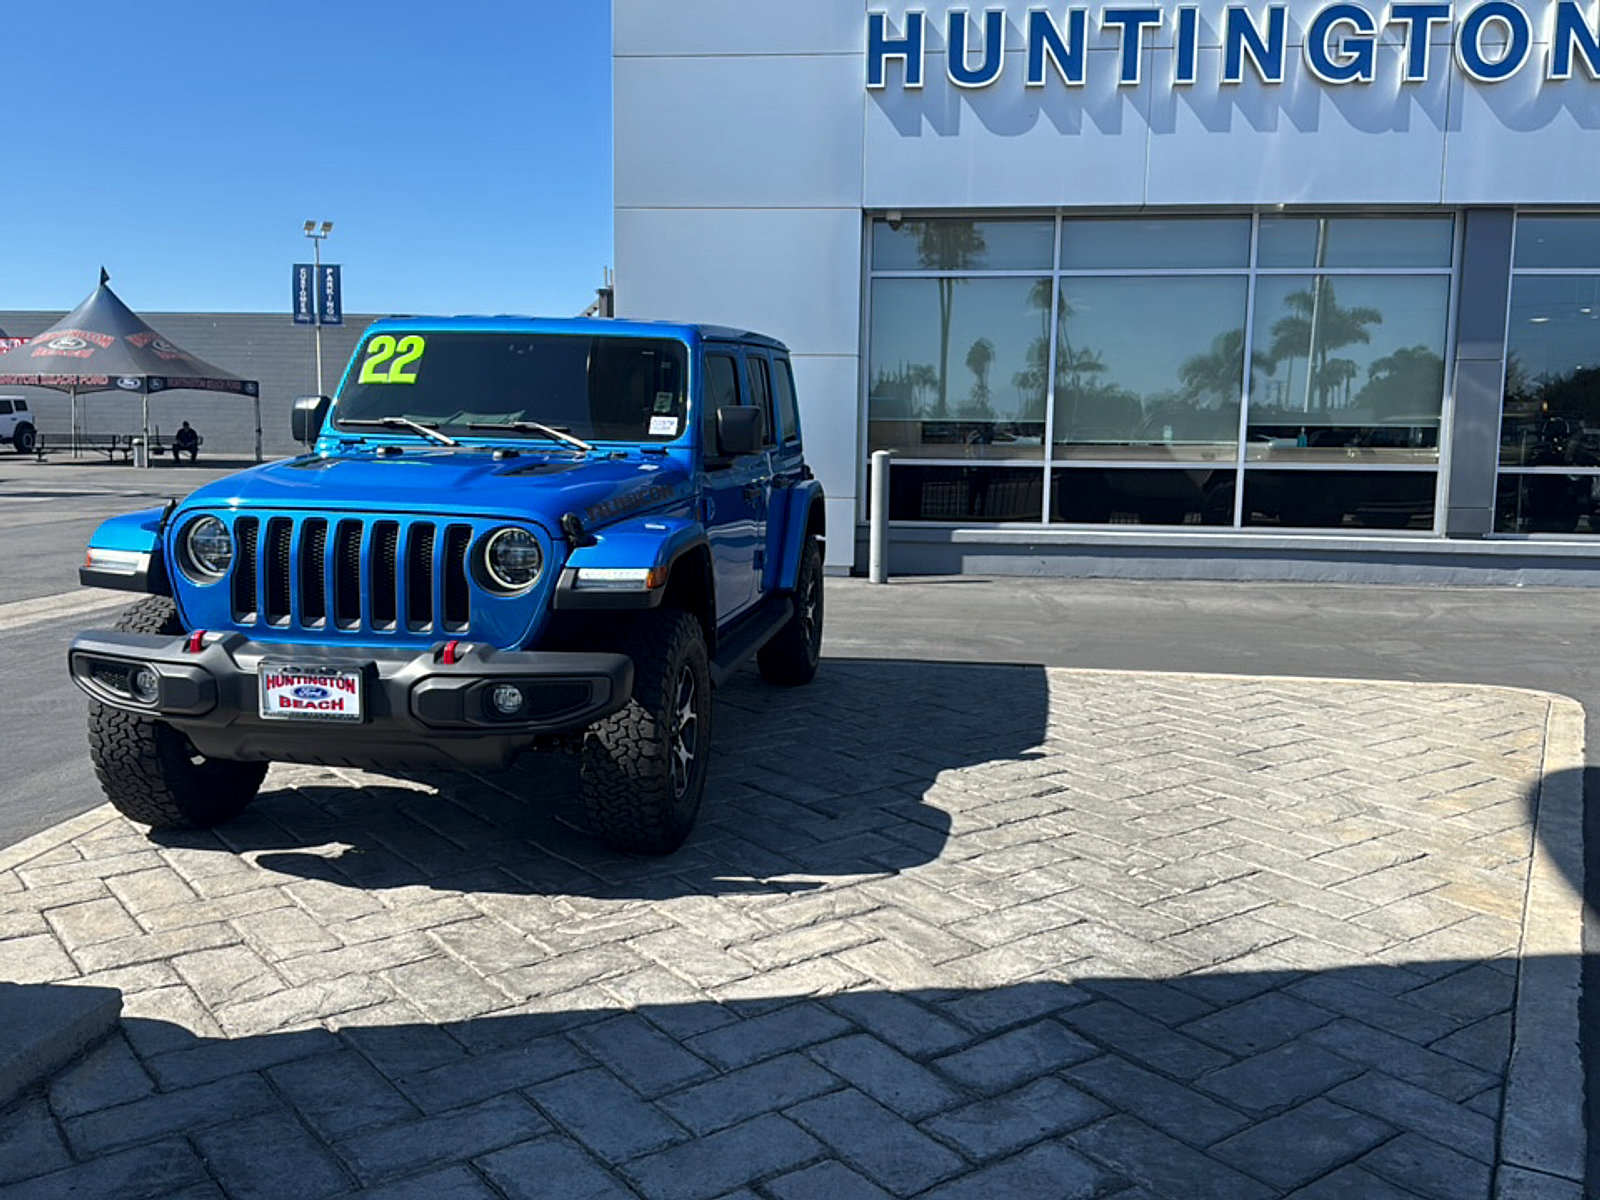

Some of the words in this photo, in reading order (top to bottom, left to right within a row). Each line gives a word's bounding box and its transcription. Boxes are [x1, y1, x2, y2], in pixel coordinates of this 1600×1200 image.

[866, 0, 1600, 88] HUNTINGTON
[326, 268, 335, 315] PARKING
[358, 335, 425, 384] 22
[584, 484, 675, 521] RUBICON
[266, 674, 356, 694] HUNTINGTON
[279, 695, 345, 711] BEACH
